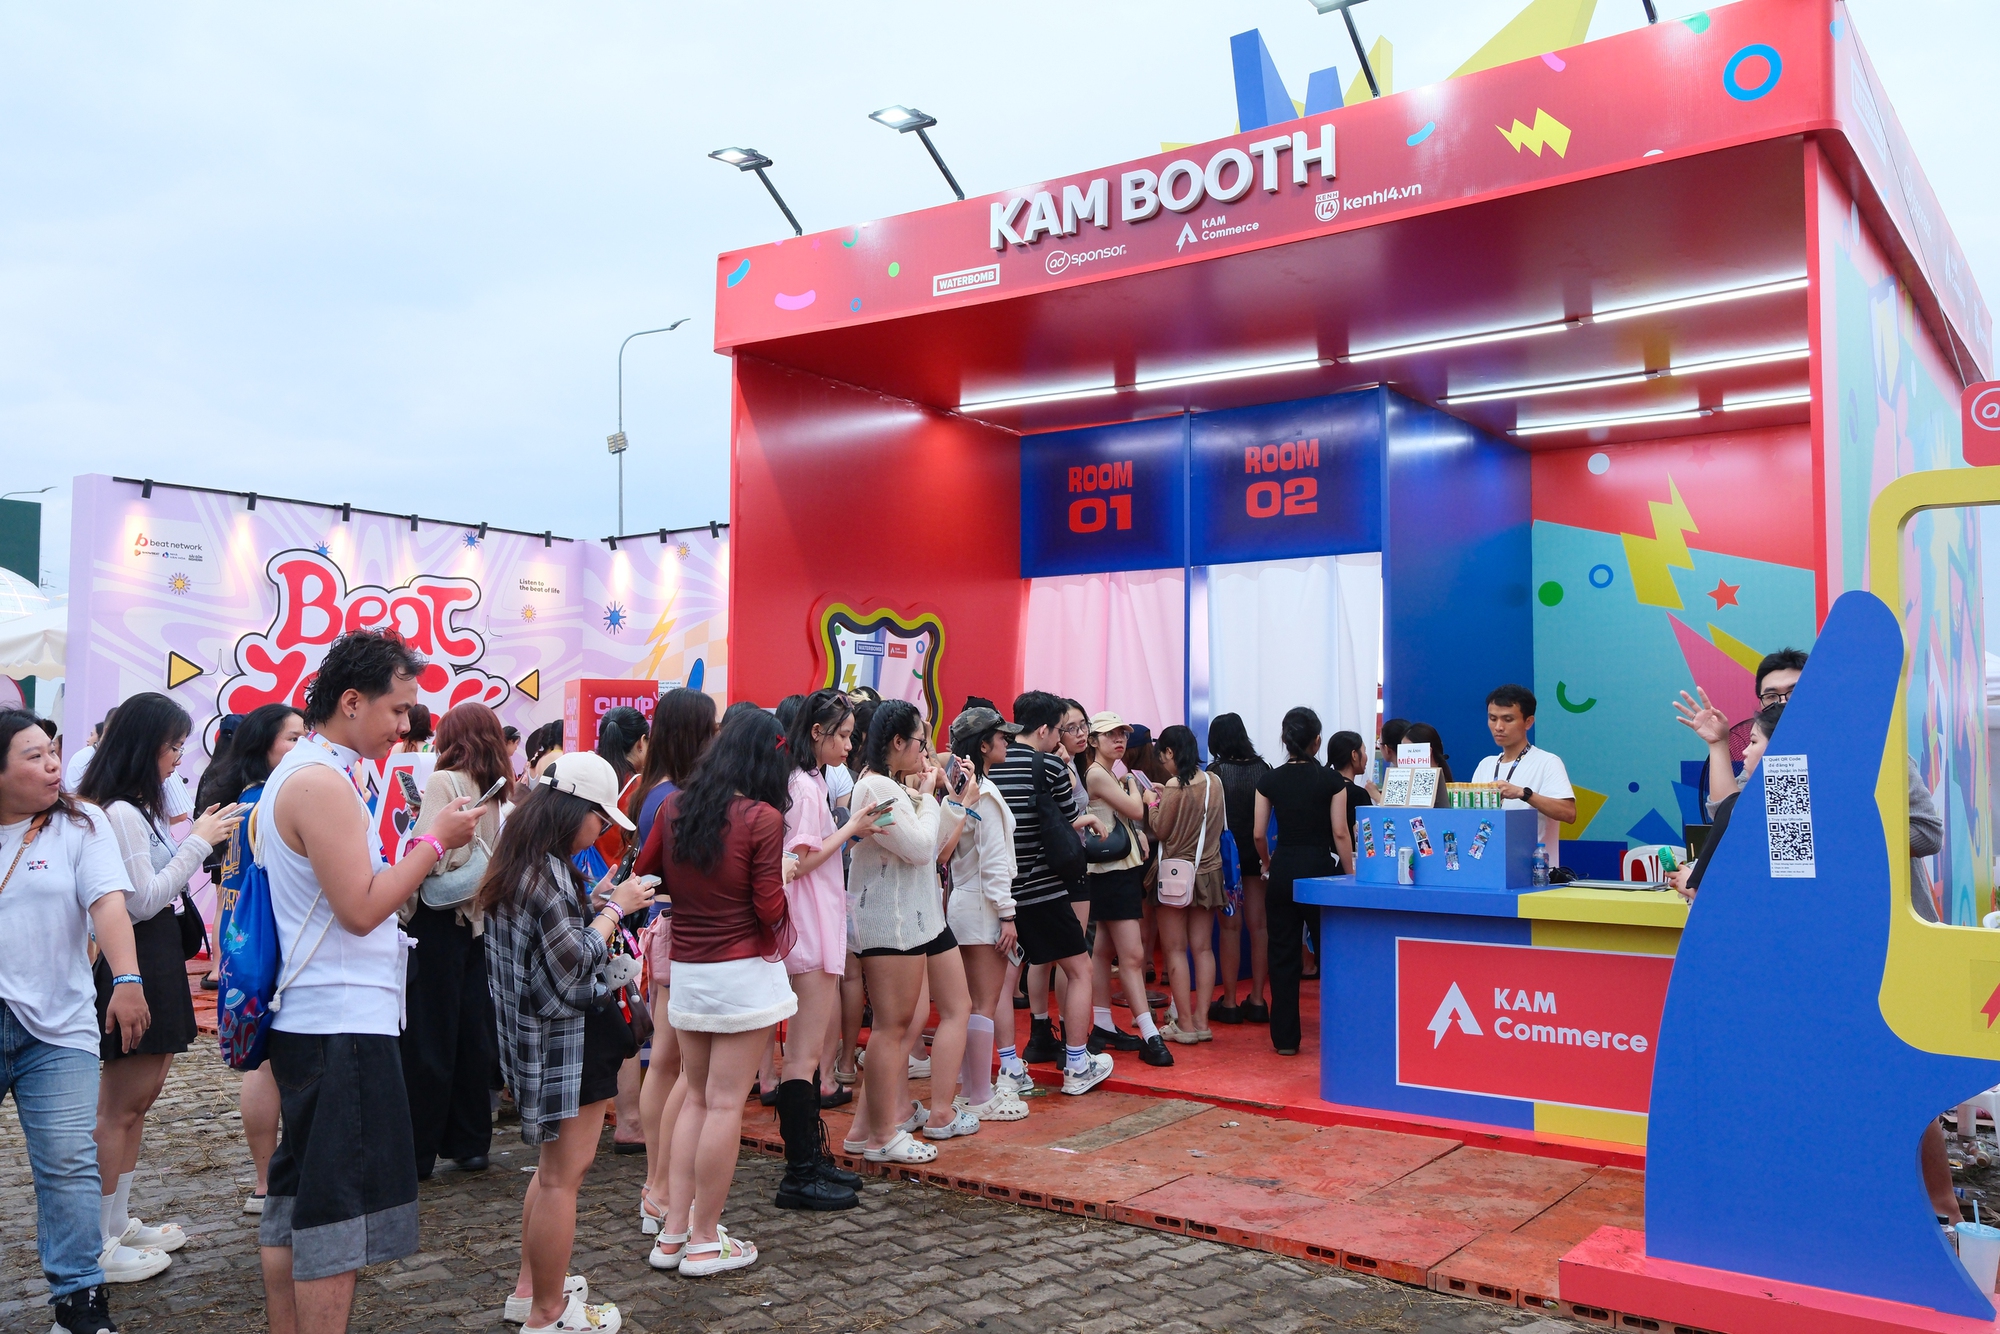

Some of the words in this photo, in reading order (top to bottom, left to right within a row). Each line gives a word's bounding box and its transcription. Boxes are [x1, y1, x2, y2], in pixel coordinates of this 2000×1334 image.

[990, 177, 1109, 250] KAM
[1121, 123, 1336, 224] BOOTH
[1317, 192, 1339, 202] KENH
[1343, 183, 1422, 211] kenh14.vn
[1201, 215, 1226, 229] KAM
[1201, 221, 1260, 241] Commerce
[939, 270, 995, 290] WATERBOMB
[1245, 438, 1319, 474] ROOM
[1068, 460, 1133, 493] ROOM
[1246, 476, 1318, 519] 02
[1068, 494, 1132, 533] 01
[150, 539, 169, 548] beat
[170, 542, 203, 551] network
[1494, 987, 1557, 1014] KAM
[1494, 1016, 1648, 1053] Commerce
